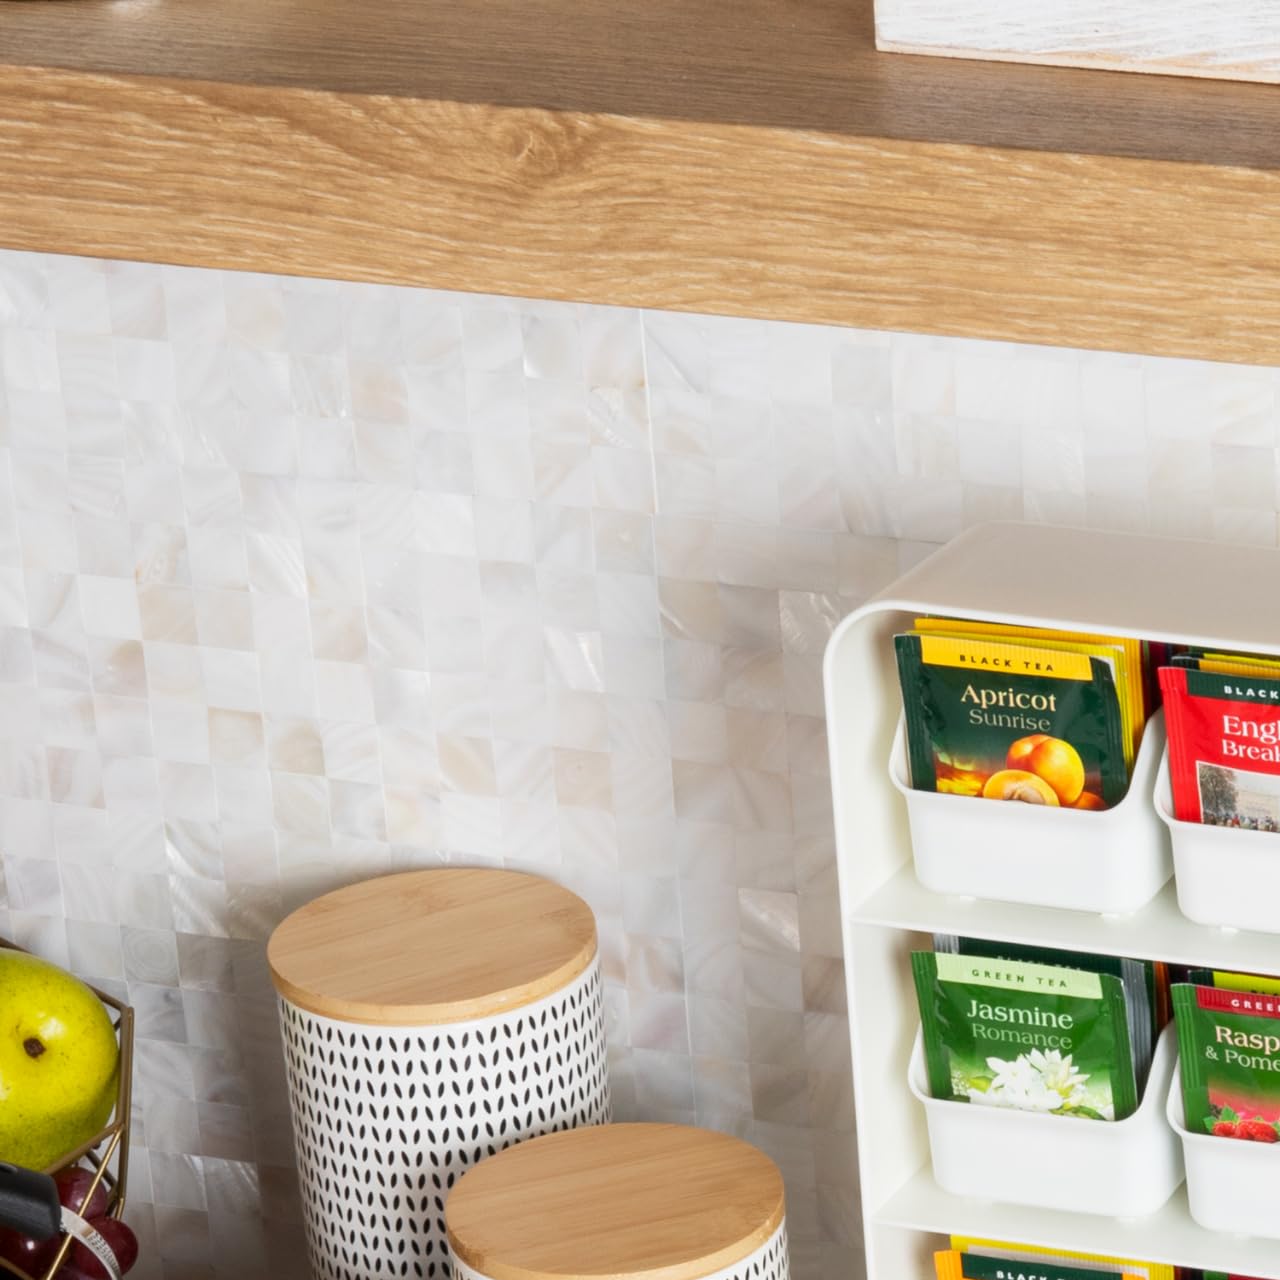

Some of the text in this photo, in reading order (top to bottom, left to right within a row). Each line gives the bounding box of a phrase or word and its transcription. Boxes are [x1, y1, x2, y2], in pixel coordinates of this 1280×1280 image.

[959, 654, 1054, 672] BLACK TEA
[960, 684, 1057, 712] Apricot
[1223, 685, 1280, 700] BLACK
[969, 709, 1051, 731] Sunrise
[971, 969, 1068, 988] GREEN TEA
[967, 999, 1074, 1030] Jasmine
[972, 1024, 1073, 1049] Romance
[1205, 1046, 1219, 1060] &
